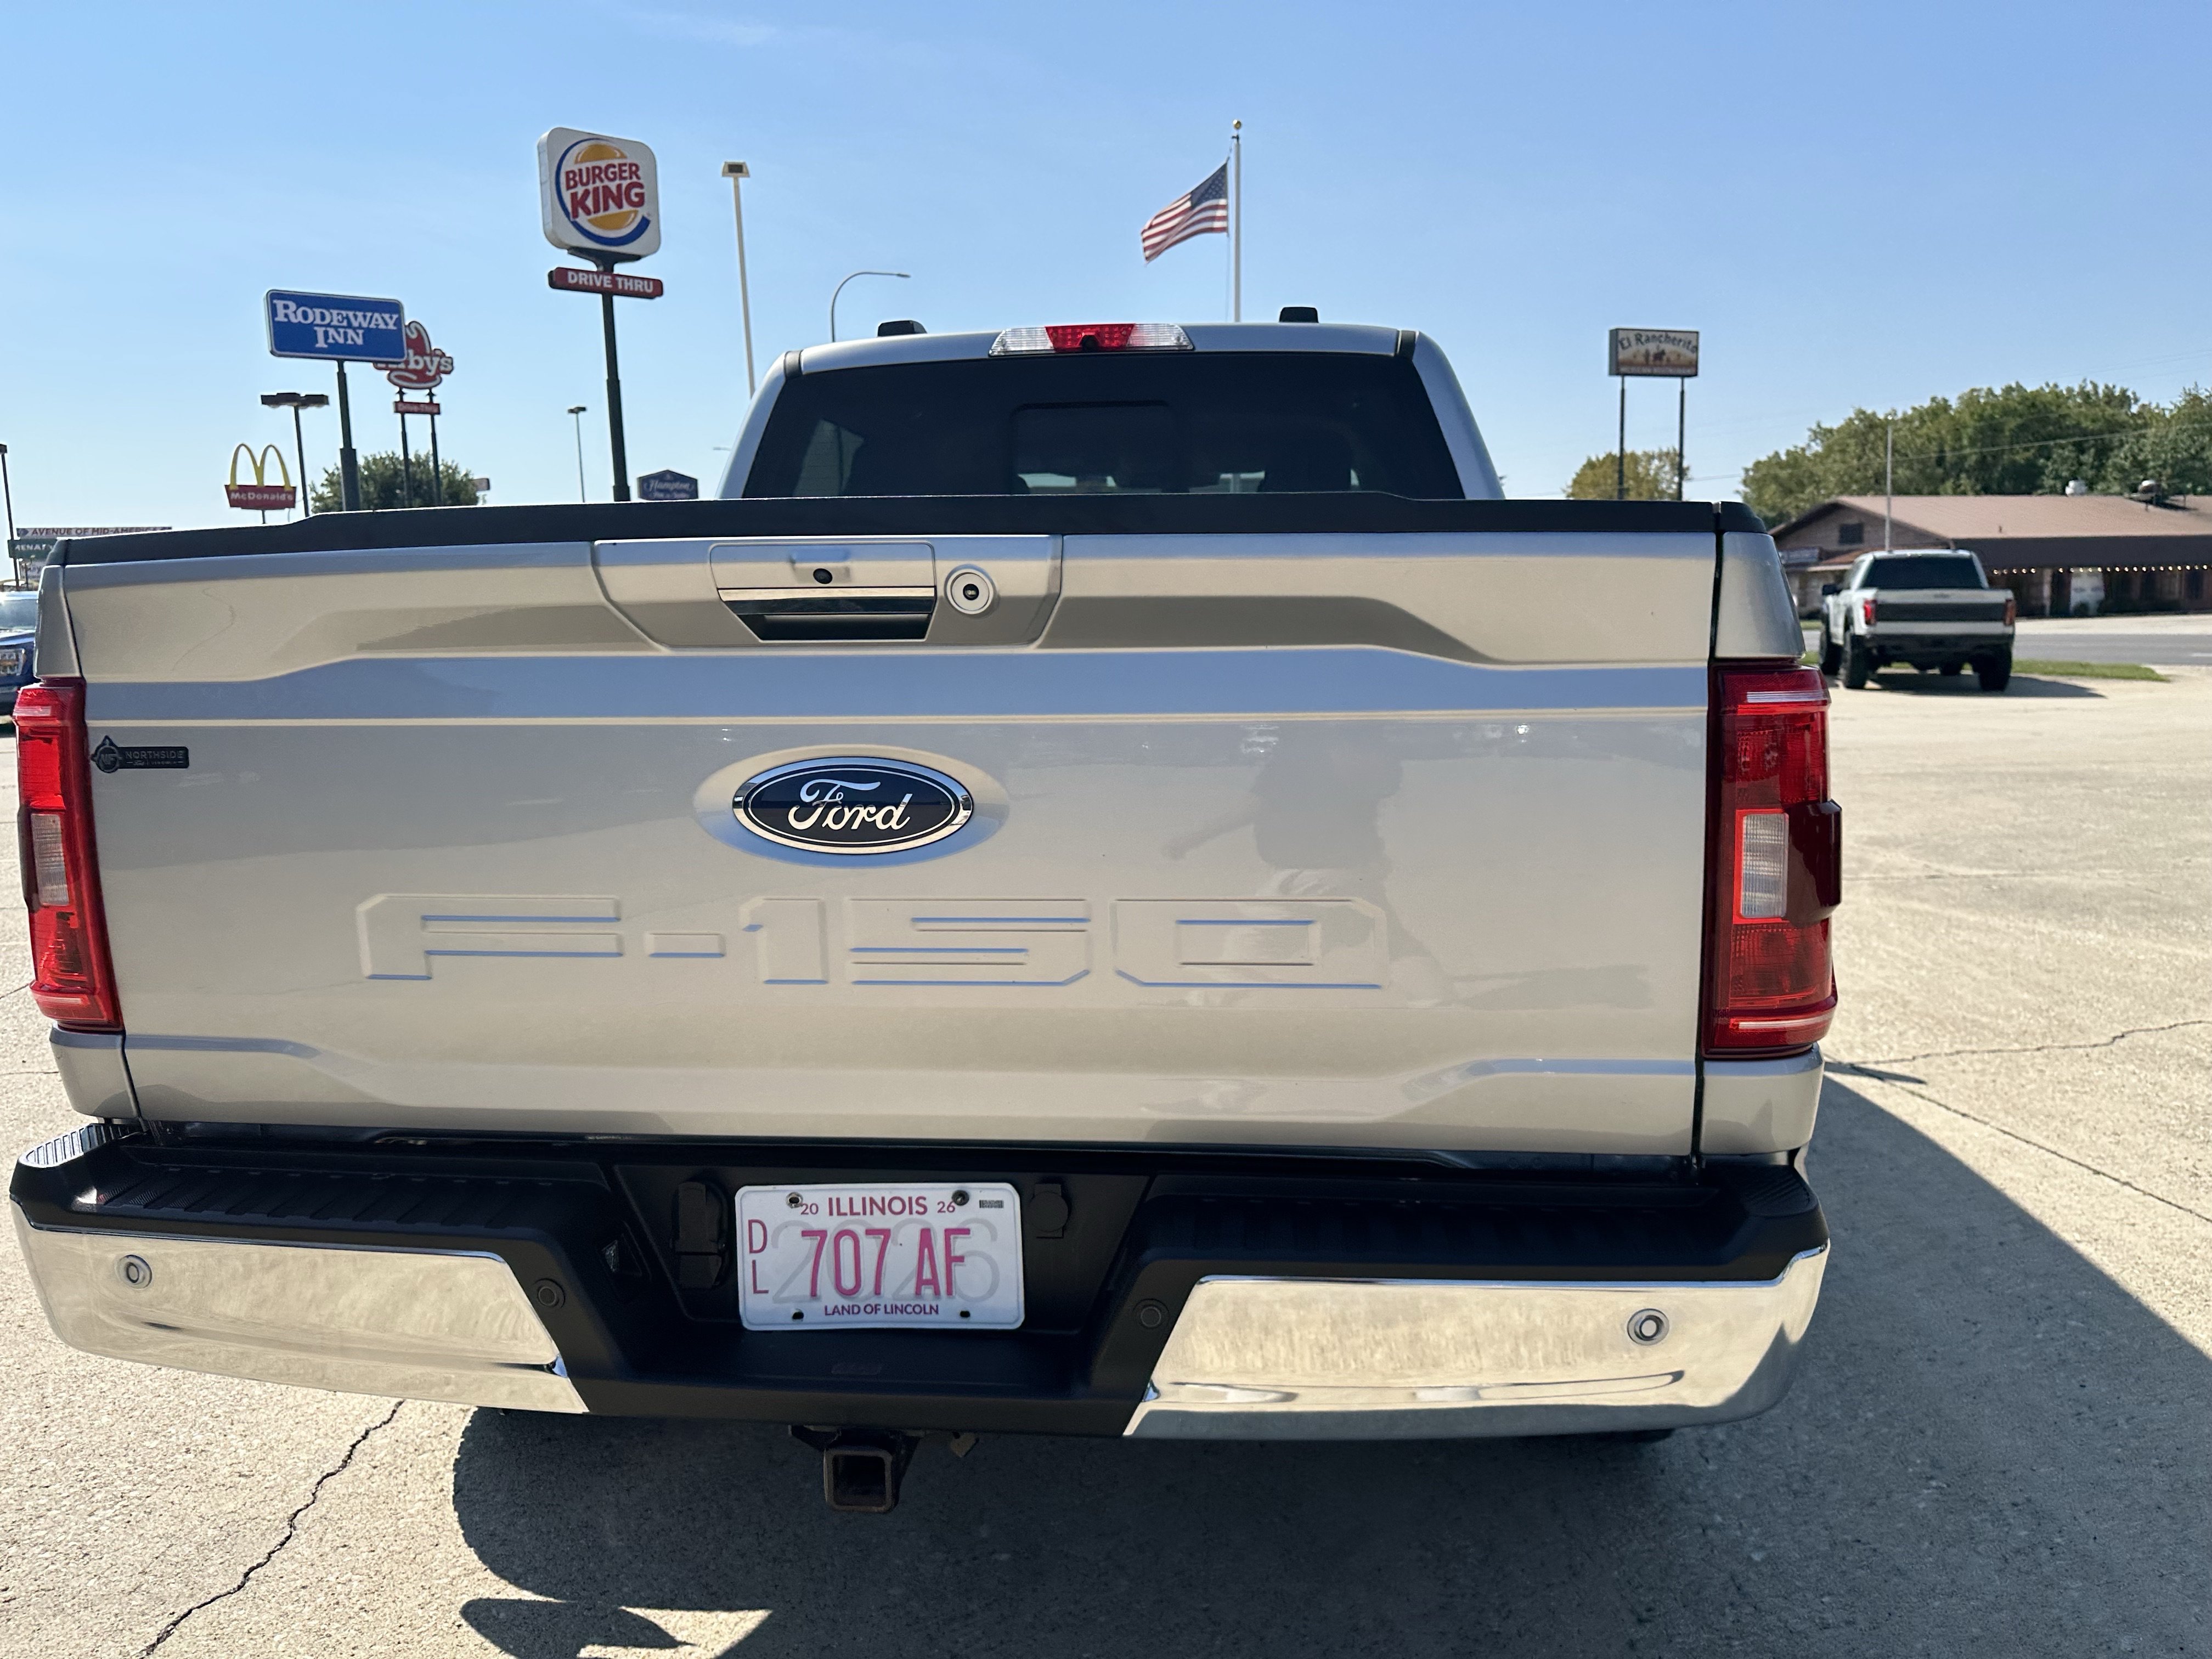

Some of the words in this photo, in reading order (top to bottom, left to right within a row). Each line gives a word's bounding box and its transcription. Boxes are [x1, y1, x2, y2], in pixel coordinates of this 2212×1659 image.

[565, 162, 641, 191] BURGER
[570, 181, 645, 219] KING
[567, 272, 613, 289] DRIVE
[615, 276, 654, 294] THRU
[273, 300, 399, 330] RODEWAY
[313, 326, 364, 348] INN
[1618, 336, 1632, 351] El
[377, 348, 453, 376] by's
[230, 492, 294, 501] McDonald's
[31, 527, 72, 535] AVENUE
[125, 751, 184, 760] NORTHSIDE
[788, 778, 913, 830] Ford
[356, 894, 1390, 990] F-150
[800, 1203, 819, 1215] 20
[828, 1195, 928, 1216] ILLINOIS
[936, 1200, 956, 1214] 26
[801, 1228, 891, 1297] 707
[915, 1228, 971, 1296] AF
[824, 1305, 861, 1316] LAND
[863, 1304, 882, 1315] OF
[884, 1304, 939, 1316] LINCOLN
